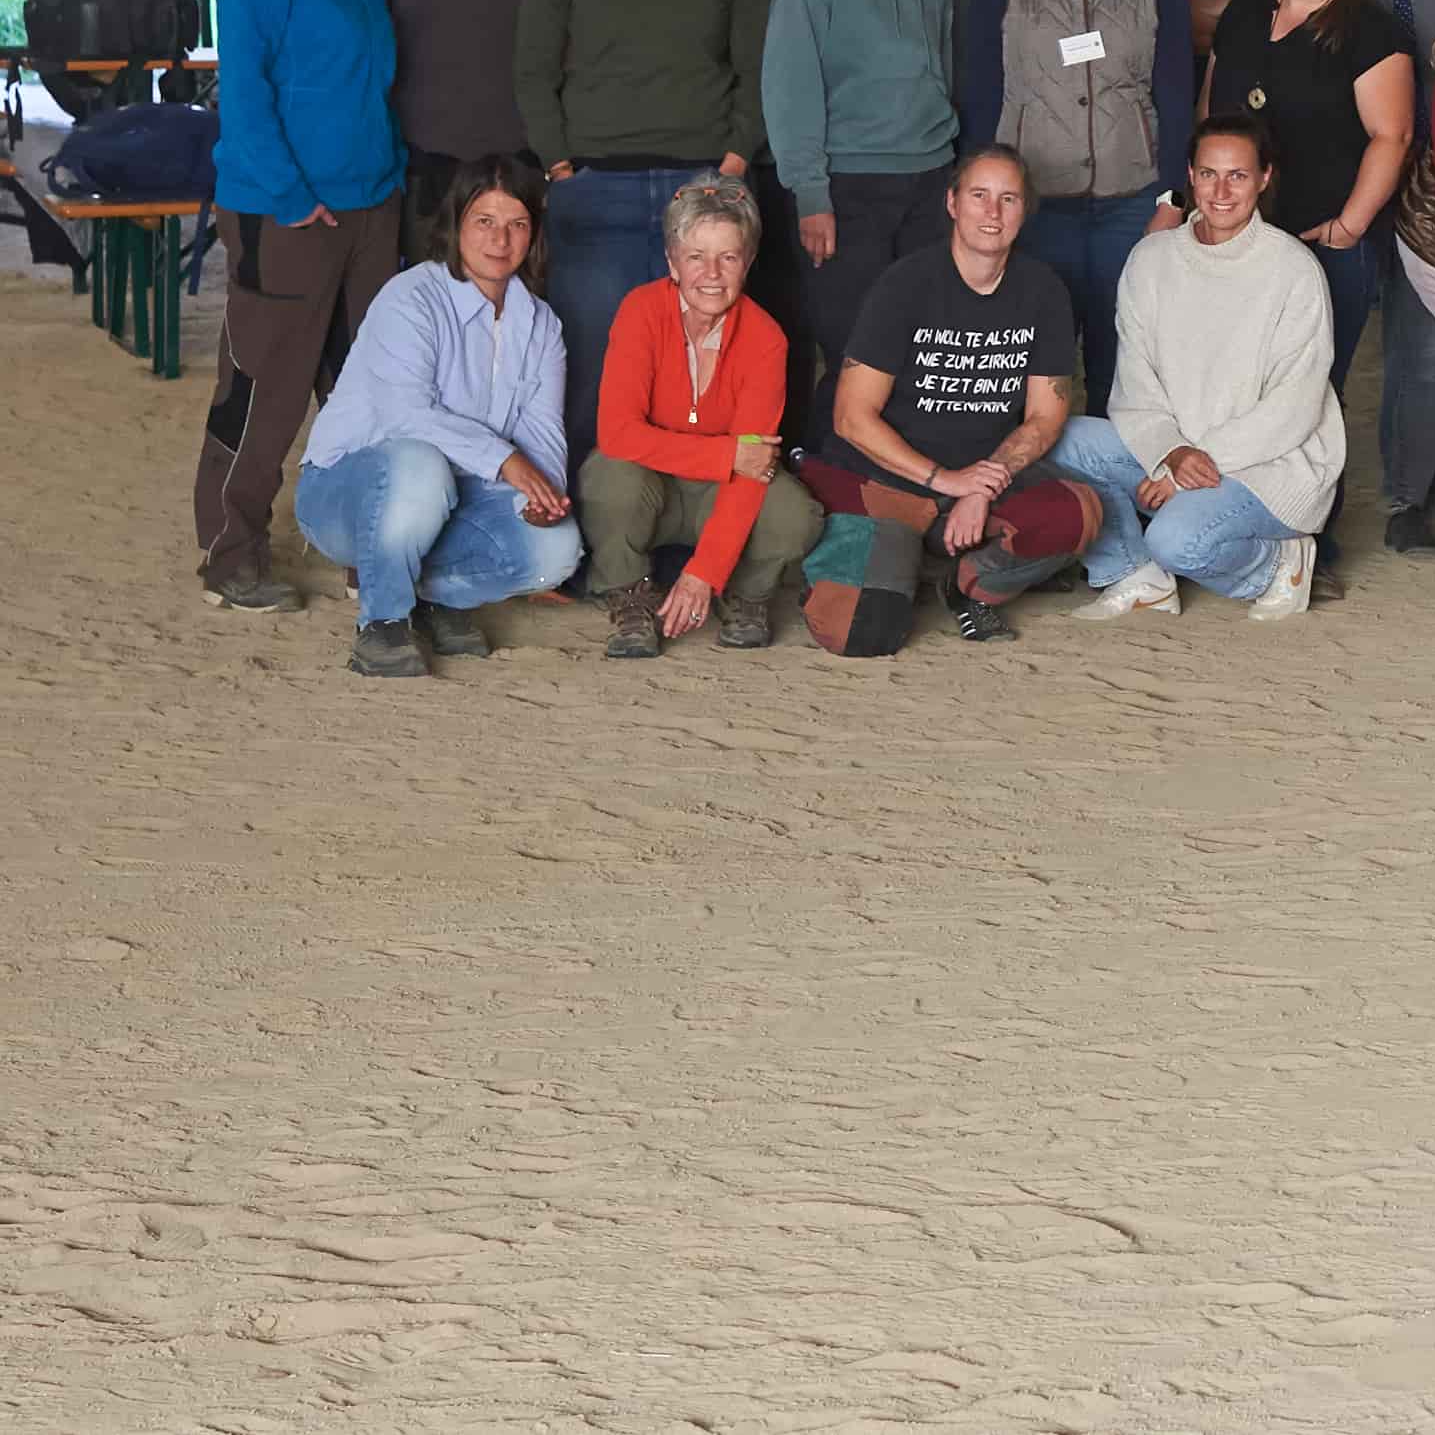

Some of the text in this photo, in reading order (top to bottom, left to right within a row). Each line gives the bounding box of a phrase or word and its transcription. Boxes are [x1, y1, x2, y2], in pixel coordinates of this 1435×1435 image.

[913, 327, 934, 344] ICH
[915, 351, 1029, 371] NIE ZUM ZIRKUS
[973, 377, 999, 394] BIN
[1000, 375, 1024, 393] ICH
